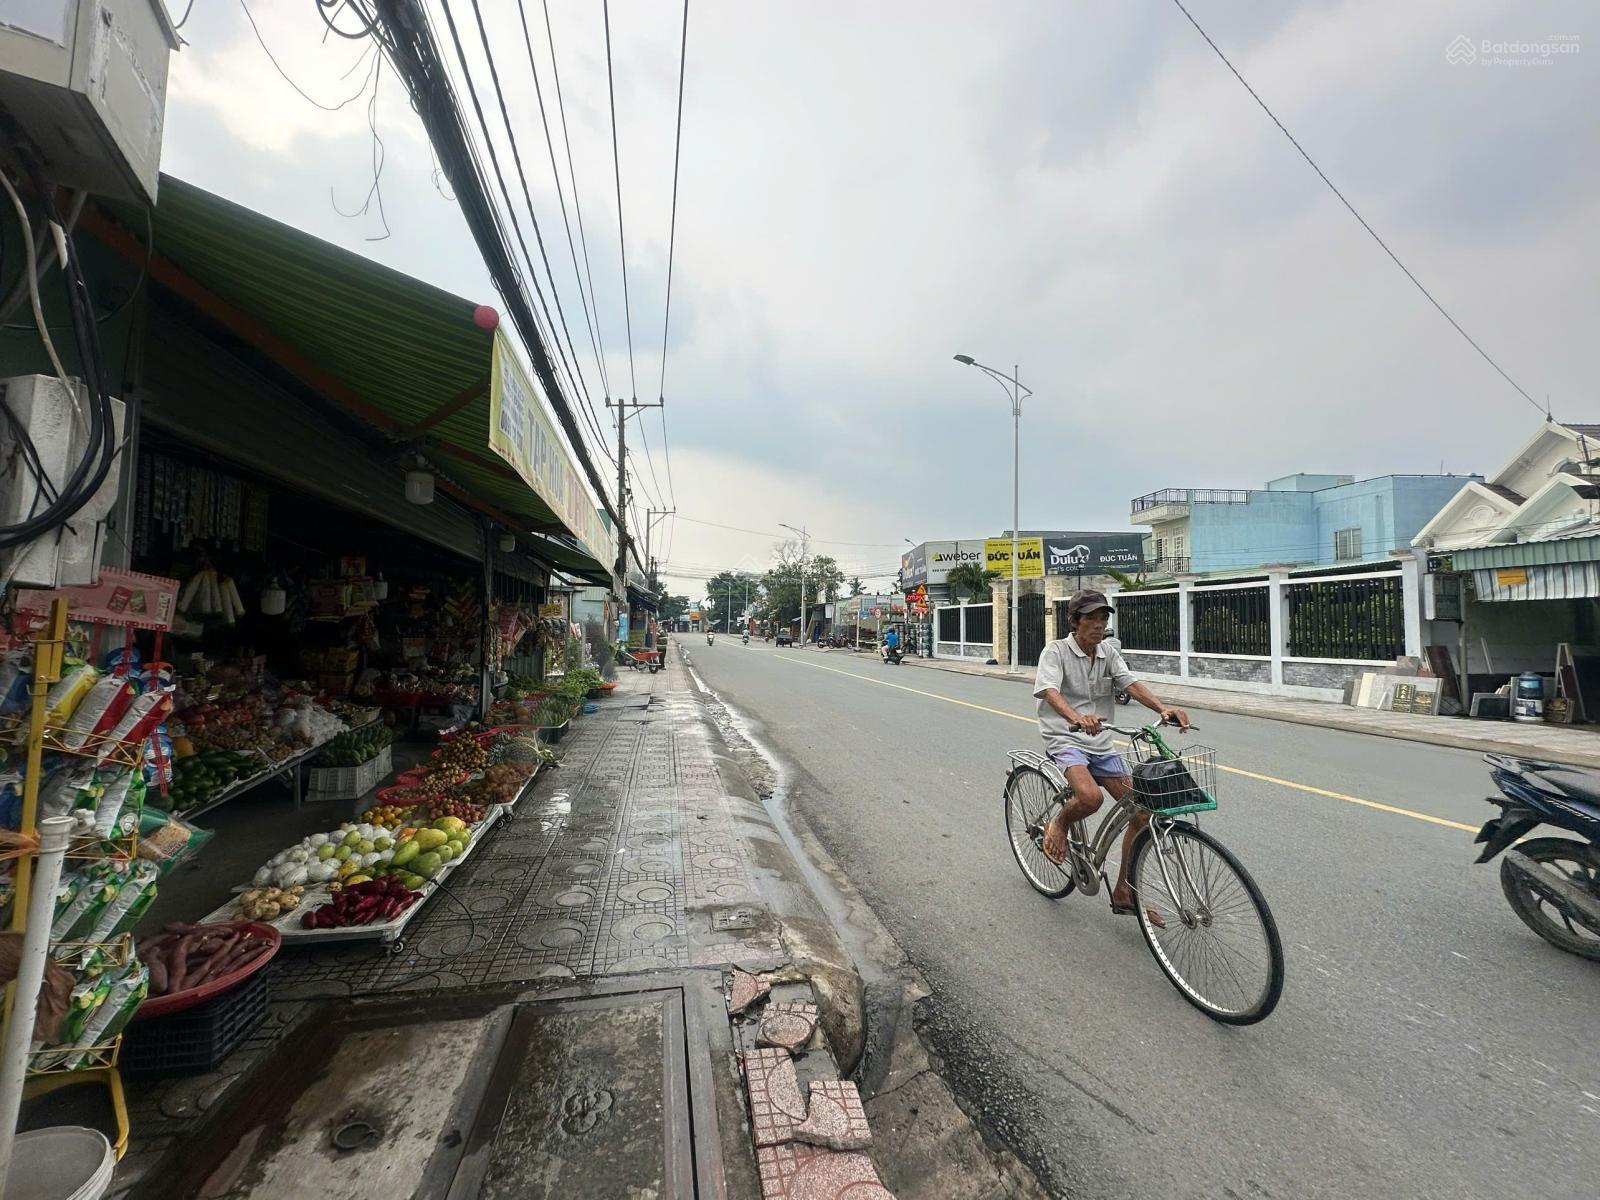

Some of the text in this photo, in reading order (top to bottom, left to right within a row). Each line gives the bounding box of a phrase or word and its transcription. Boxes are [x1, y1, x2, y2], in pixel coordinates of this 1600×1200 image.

[941, 550, 982, 561] weber
[987, 548, 1040, 562] ĐỨC UẤN
[1050, 554, 1086, 565] Dulux
